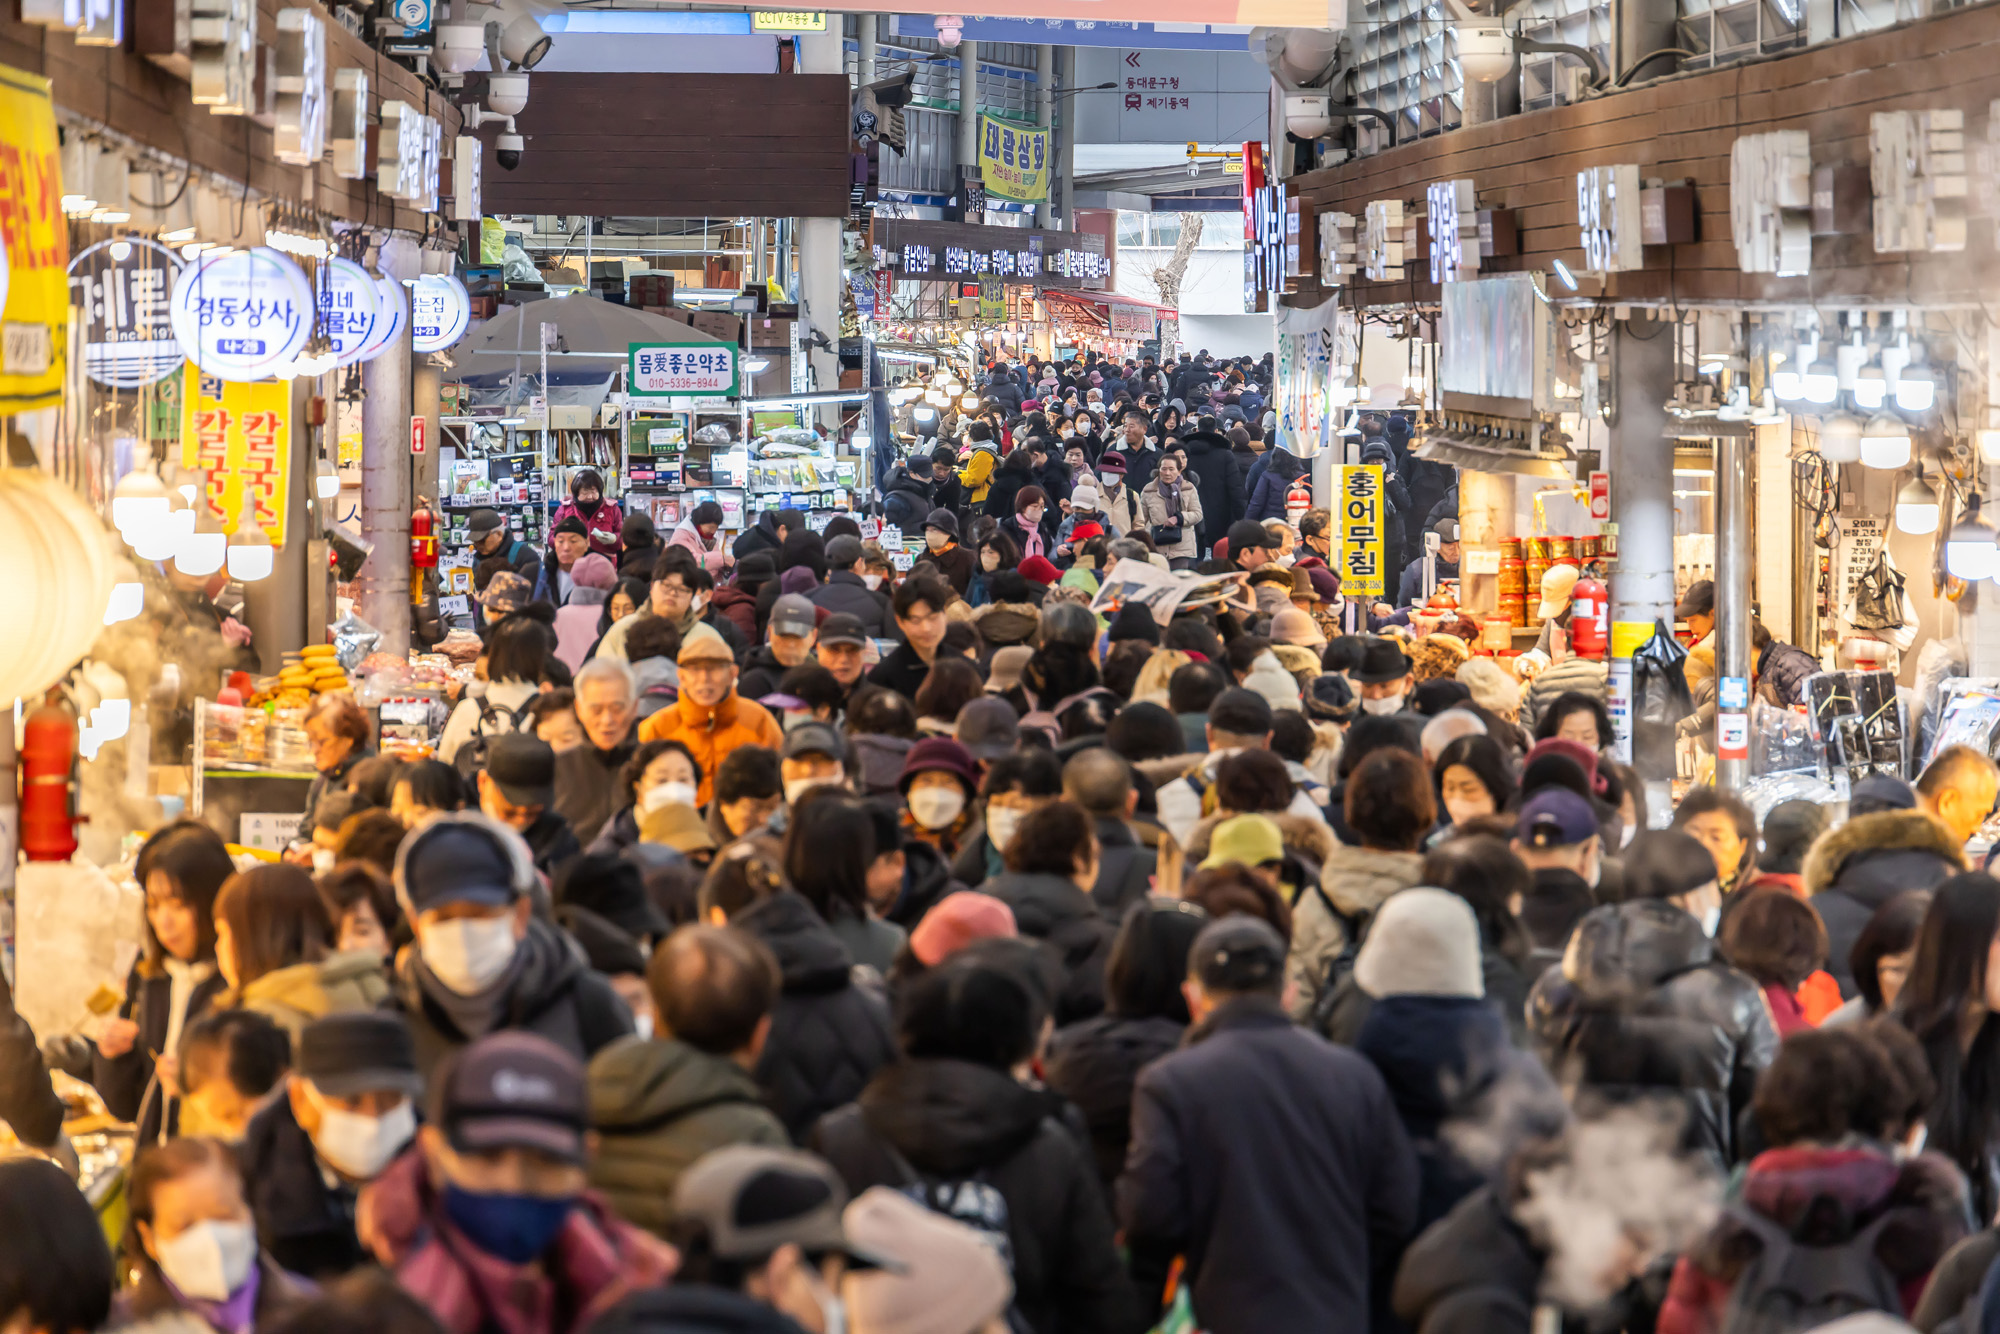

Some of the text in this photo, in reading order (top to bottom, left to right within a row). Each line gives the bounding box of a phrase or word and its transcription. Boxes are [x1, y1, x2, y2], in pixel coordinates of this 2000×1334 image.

[758, 12, 784, 23] CCTV
[1125, 76, 1180, 90] 동대문구청
[1146, 96, 1189, 110] 제기동역
[984, 121, 1045, 170] 대광상회
[904, 244, 929, 273] 충남인삼
[193, 297, 293, 328] 경동상사
[648, 378, 719, 389] 010-5336-8944
[1347, 472, 1378, 575] 홍어무침
[1852, 519, 1876, 528] 오이지
